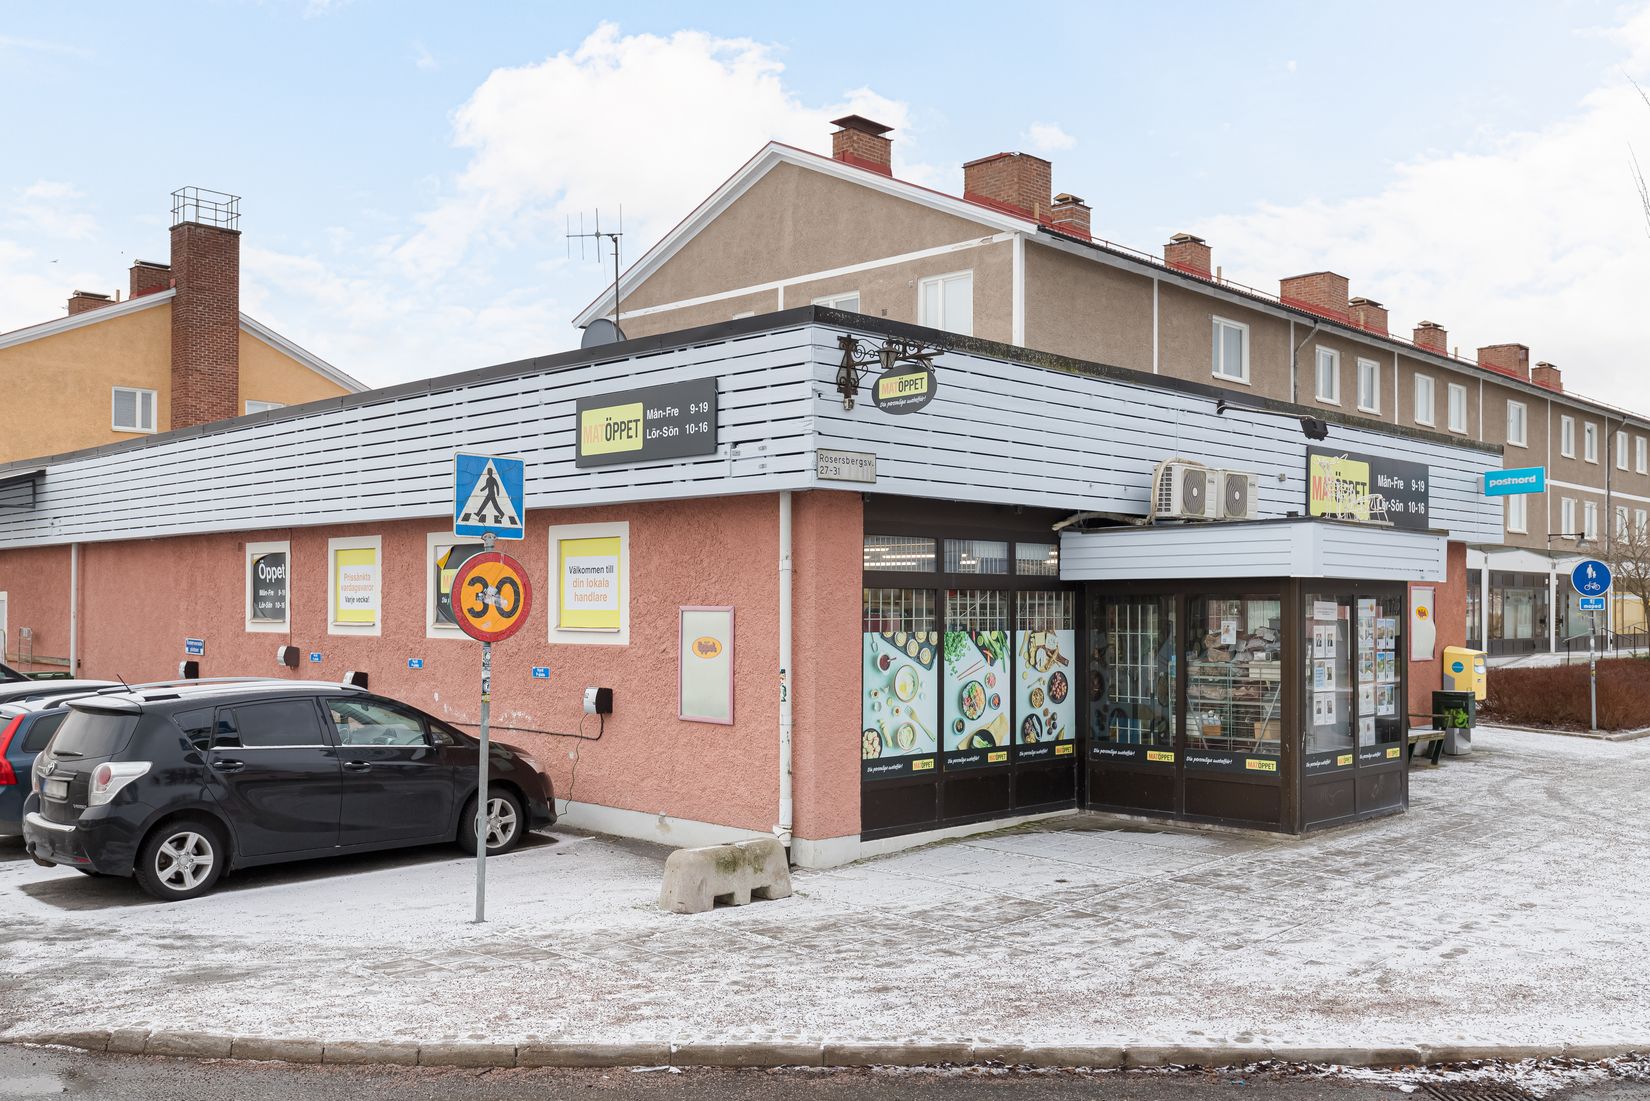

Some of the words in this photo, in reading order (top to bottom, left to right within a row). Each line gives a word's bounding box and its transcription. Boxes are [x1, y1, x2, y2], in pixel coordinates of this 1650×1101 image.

[881, 377, 925, 395] MATÖPPET
[646, 406, 679, 420] Mån-Fre
[689, 401, 709, 414] 9-19
[584, 417, 641, 443] MATÖPPET
[646, 426, 679, 439] Lör-Sön
[685, 421, 709, 435] 10-16
[819, 453, 875, 468] Rosersbergsv.
[819, 466, 840, 475] 27-31
[1378, 474, 1404, 489] Mån-Fre
[1411, 480, 1425, 492] 9-19
[1489, 475, 1536, 488] postnord
[1408, 501, 1425, 514] 10-16
[258, 560, 286, 583] Öppet
[569, 565, 604, 575] Välkommen
[605, 564, 614, 574] till
[572, 577, 584, 588] din
[586, 577, 609, 588] lokala
[344, 595, 355, 605] Varje
[355, 595, 370, 603] vecka!
[467, 576, 520, 618] 30
[574, 591, 608, 602] handlare
[1148, 752, 1173, 761] MATÖPPET
[1247, 760, 1275, 770] MATÖPPET
